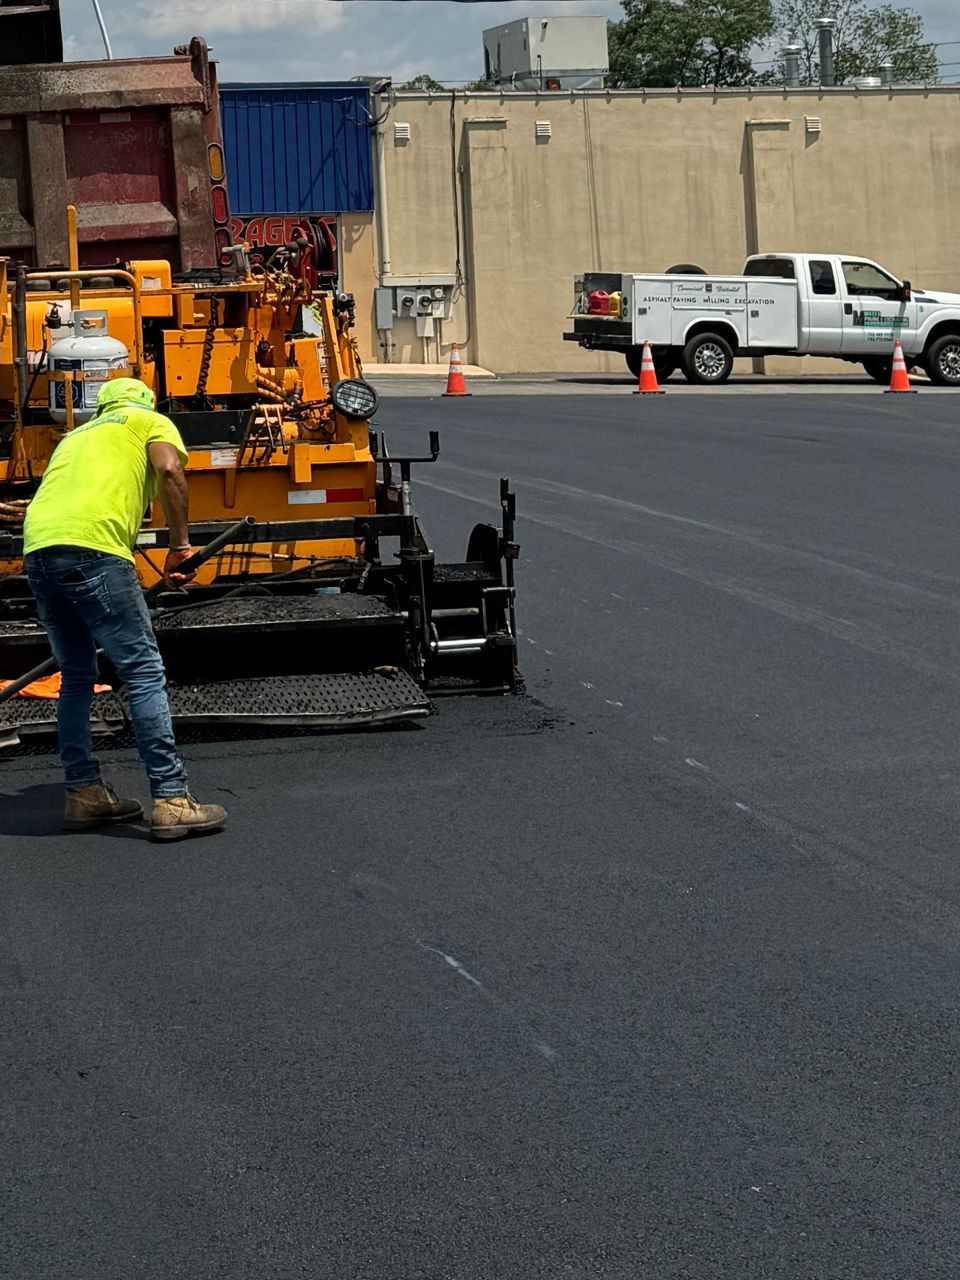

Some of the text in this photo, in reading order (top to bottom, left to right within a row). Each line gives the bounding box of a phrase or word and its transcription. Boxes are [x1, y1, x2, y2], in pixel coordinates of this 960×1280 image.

[672, 296, 697, 304] PAVING
[703, 295, 730, 305] MILLING
[734, 297, 775, 305] EXCAVATION
